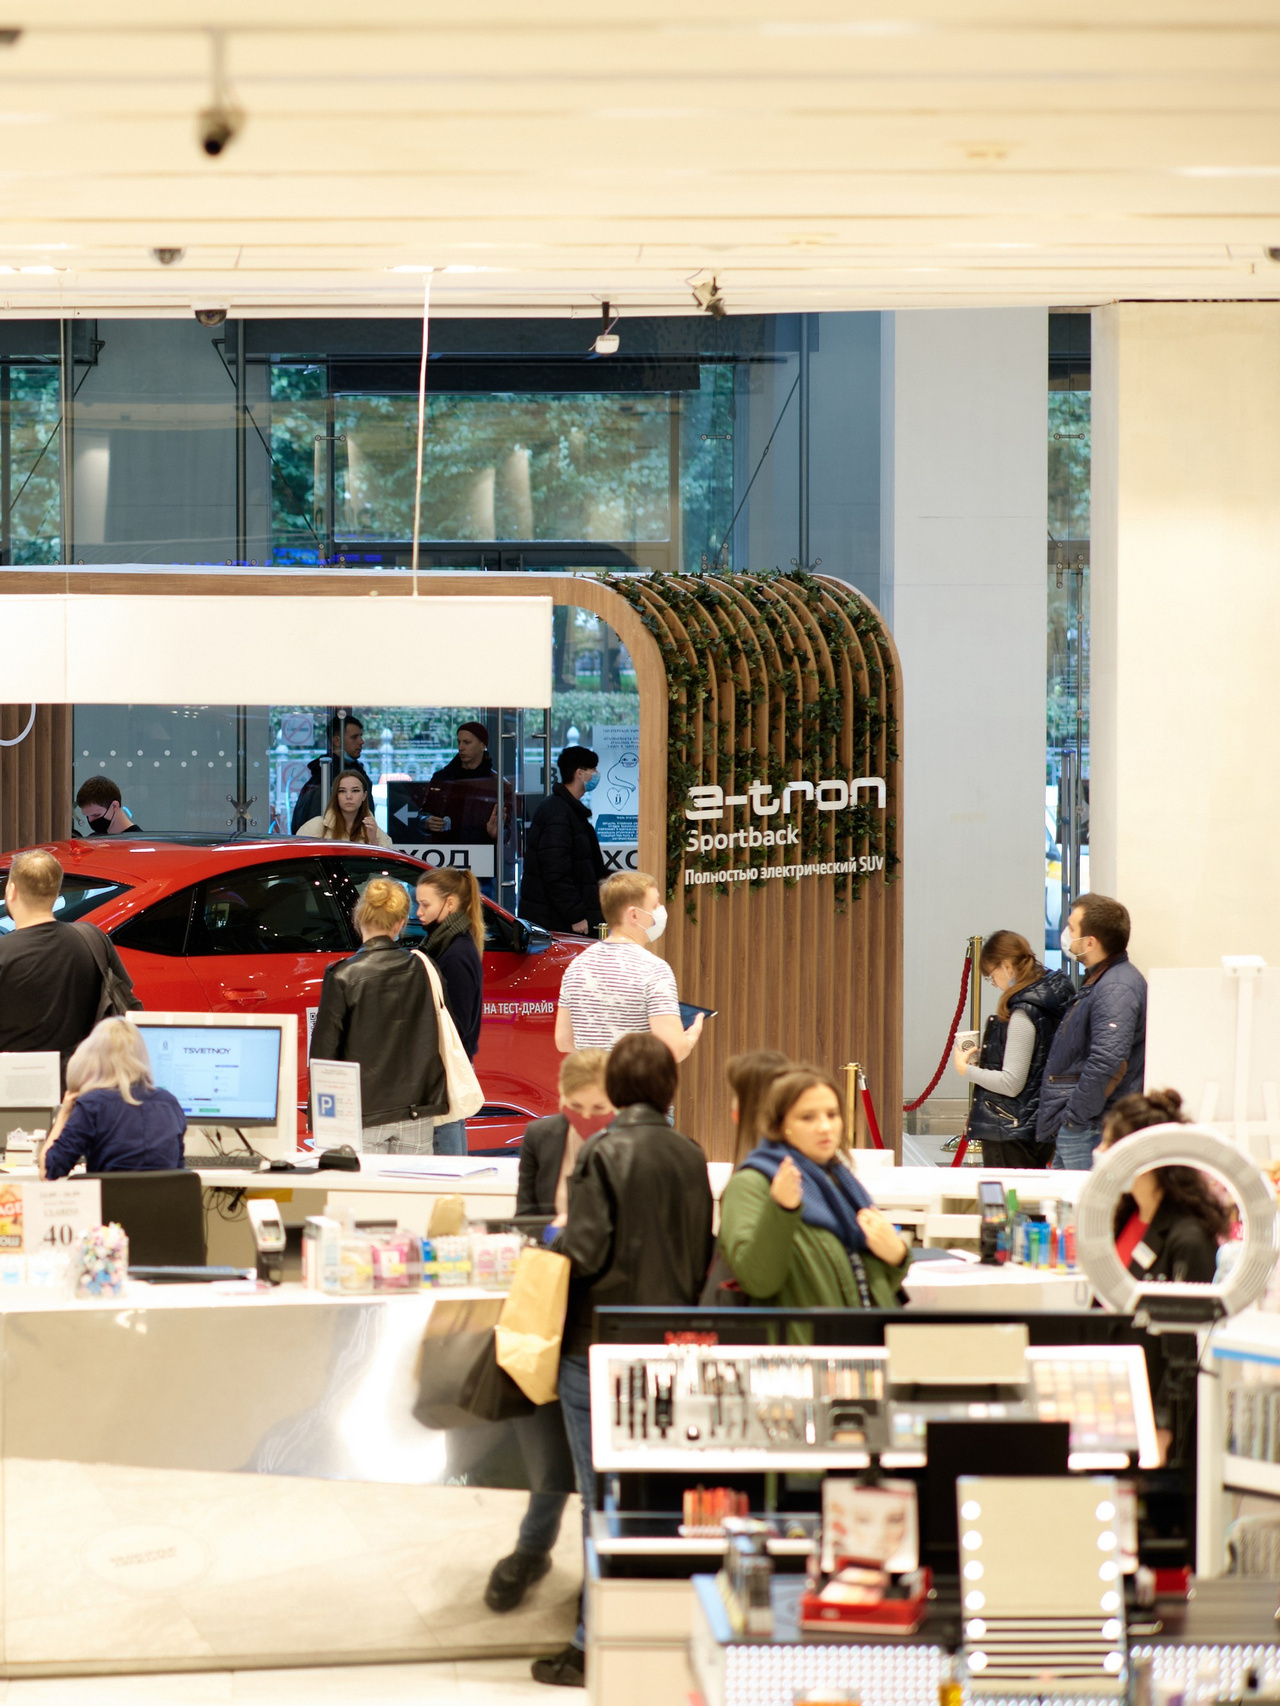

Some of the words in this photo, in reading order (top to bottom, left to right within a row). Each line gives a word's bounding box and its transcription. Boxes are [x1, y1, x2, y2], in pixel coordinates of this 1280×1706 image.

[685, 777, 887, 821] e-tron
[685, 824, 800, 854] Sportback
[685, 864, 759, 885] Полностью
[760, 857, 857, 881] электрический
[859, 855, 885, 872] SUV
[483, 1002, 497, 1014] НА
[498, 1000, 554, 1015] ТЕСТ-ДРАЙВ
[183, 1047, 232, 1055] TSVETNOY
